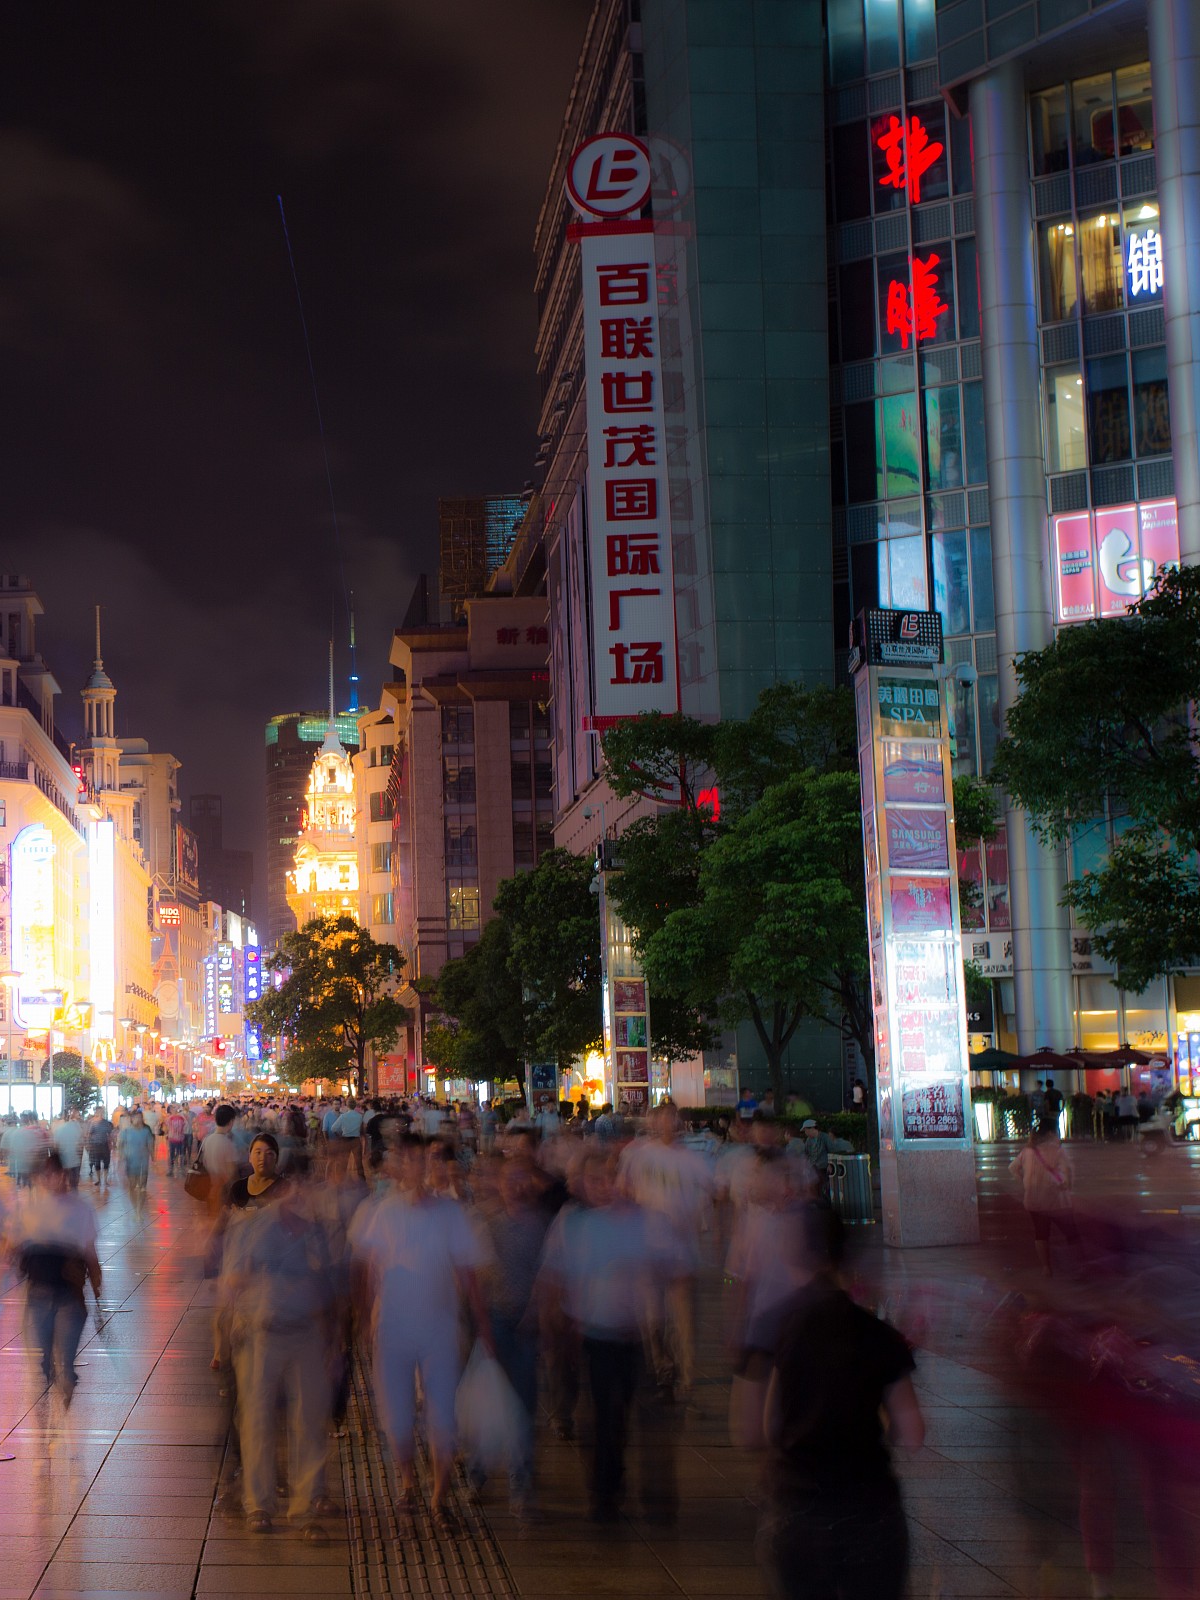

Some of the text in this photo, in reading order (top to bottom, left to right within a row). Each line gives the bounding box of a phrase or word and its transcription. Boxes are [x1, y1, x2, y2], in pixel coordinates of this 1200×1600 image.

[596, 262, 664, 685] 百联世茂国际广场
[889, 707, 926, 725] SPA
[891, 828, 941, 840] SAMSUNG
